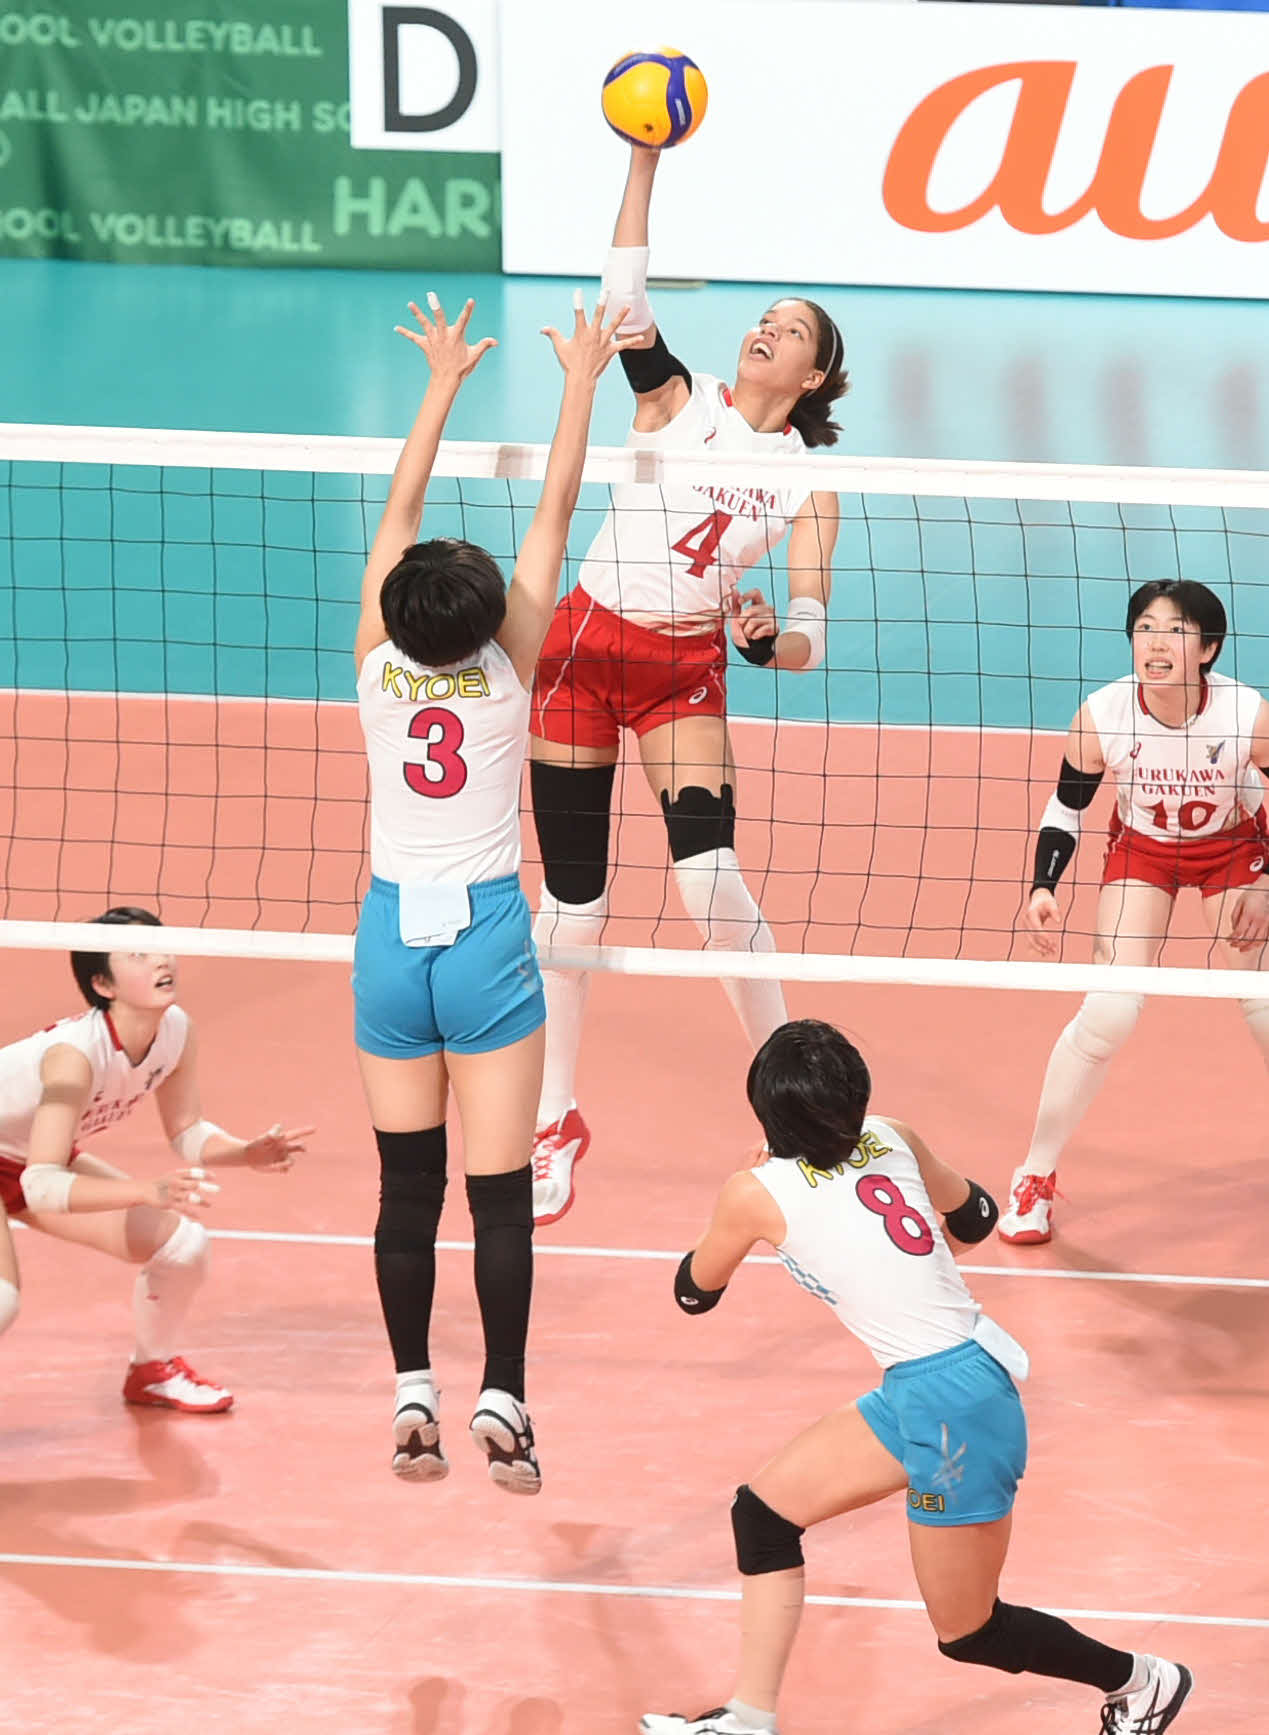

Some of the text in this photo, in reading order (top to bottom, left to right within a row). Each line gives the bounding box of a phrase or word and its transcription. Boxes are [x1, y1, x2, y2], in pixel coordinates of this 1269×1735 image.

[88, 17, 323, 56] VOLLEYBALL
[381, 6, 478, 133] D
[0, 89, 69, 123] ALL
[75, 93, 197, 127] JAPAN
[206, 97, 301, 132] HIGH
[333, 175, 500, 238] HAR
[0, 207, 323, 252] OOL VOLLEYBALL
[671, 509, 733, 579] 4
[382, 661, 491, 701] KYOEI
[403, 706, 467, 799] 3
[1135, 767, 1225, 783] URUKAWA
[1143, 800, 1219, 831] 10
[855, 1173, 935, 1256] 8
